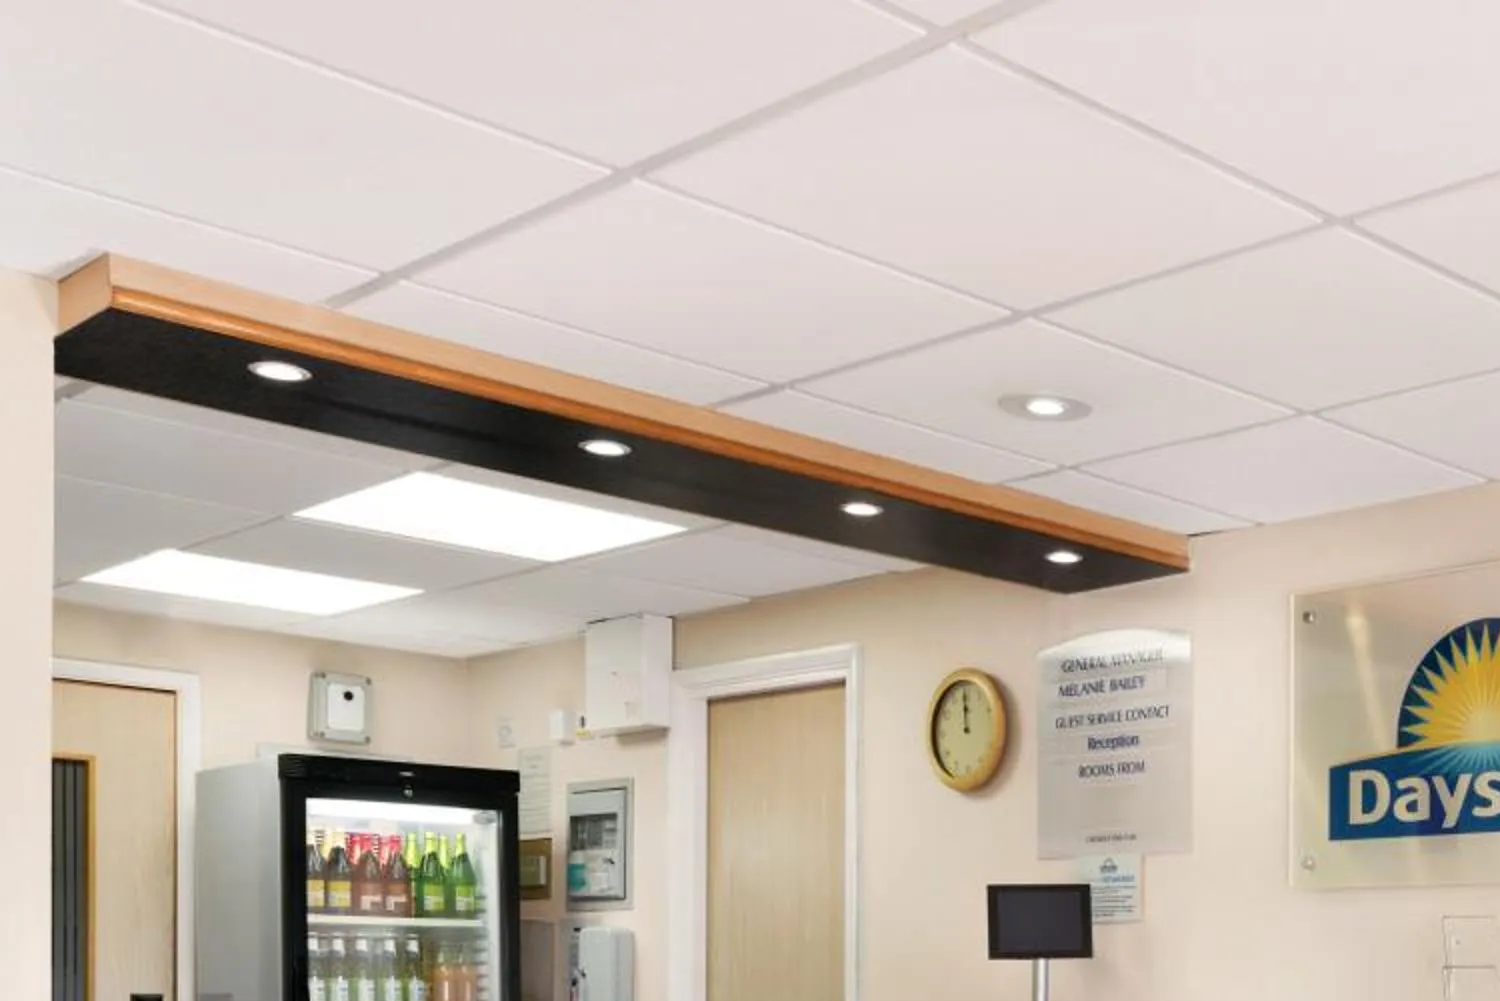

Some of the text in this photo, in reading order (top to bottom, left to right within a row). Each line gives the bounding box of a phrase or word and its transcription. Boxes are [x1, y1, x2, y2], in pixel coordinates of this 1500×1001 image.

[1060, 656, 1107, 673] GENERAL
[1058, 675, 1145, 697] MELANIE BAILEY
[1055, 704, 1170, 729] GUEST SERVICE CONTACT
[1087, 735, 1140, 751] Reception
[1078, 759, 1145, 779] ROOMS FROM
